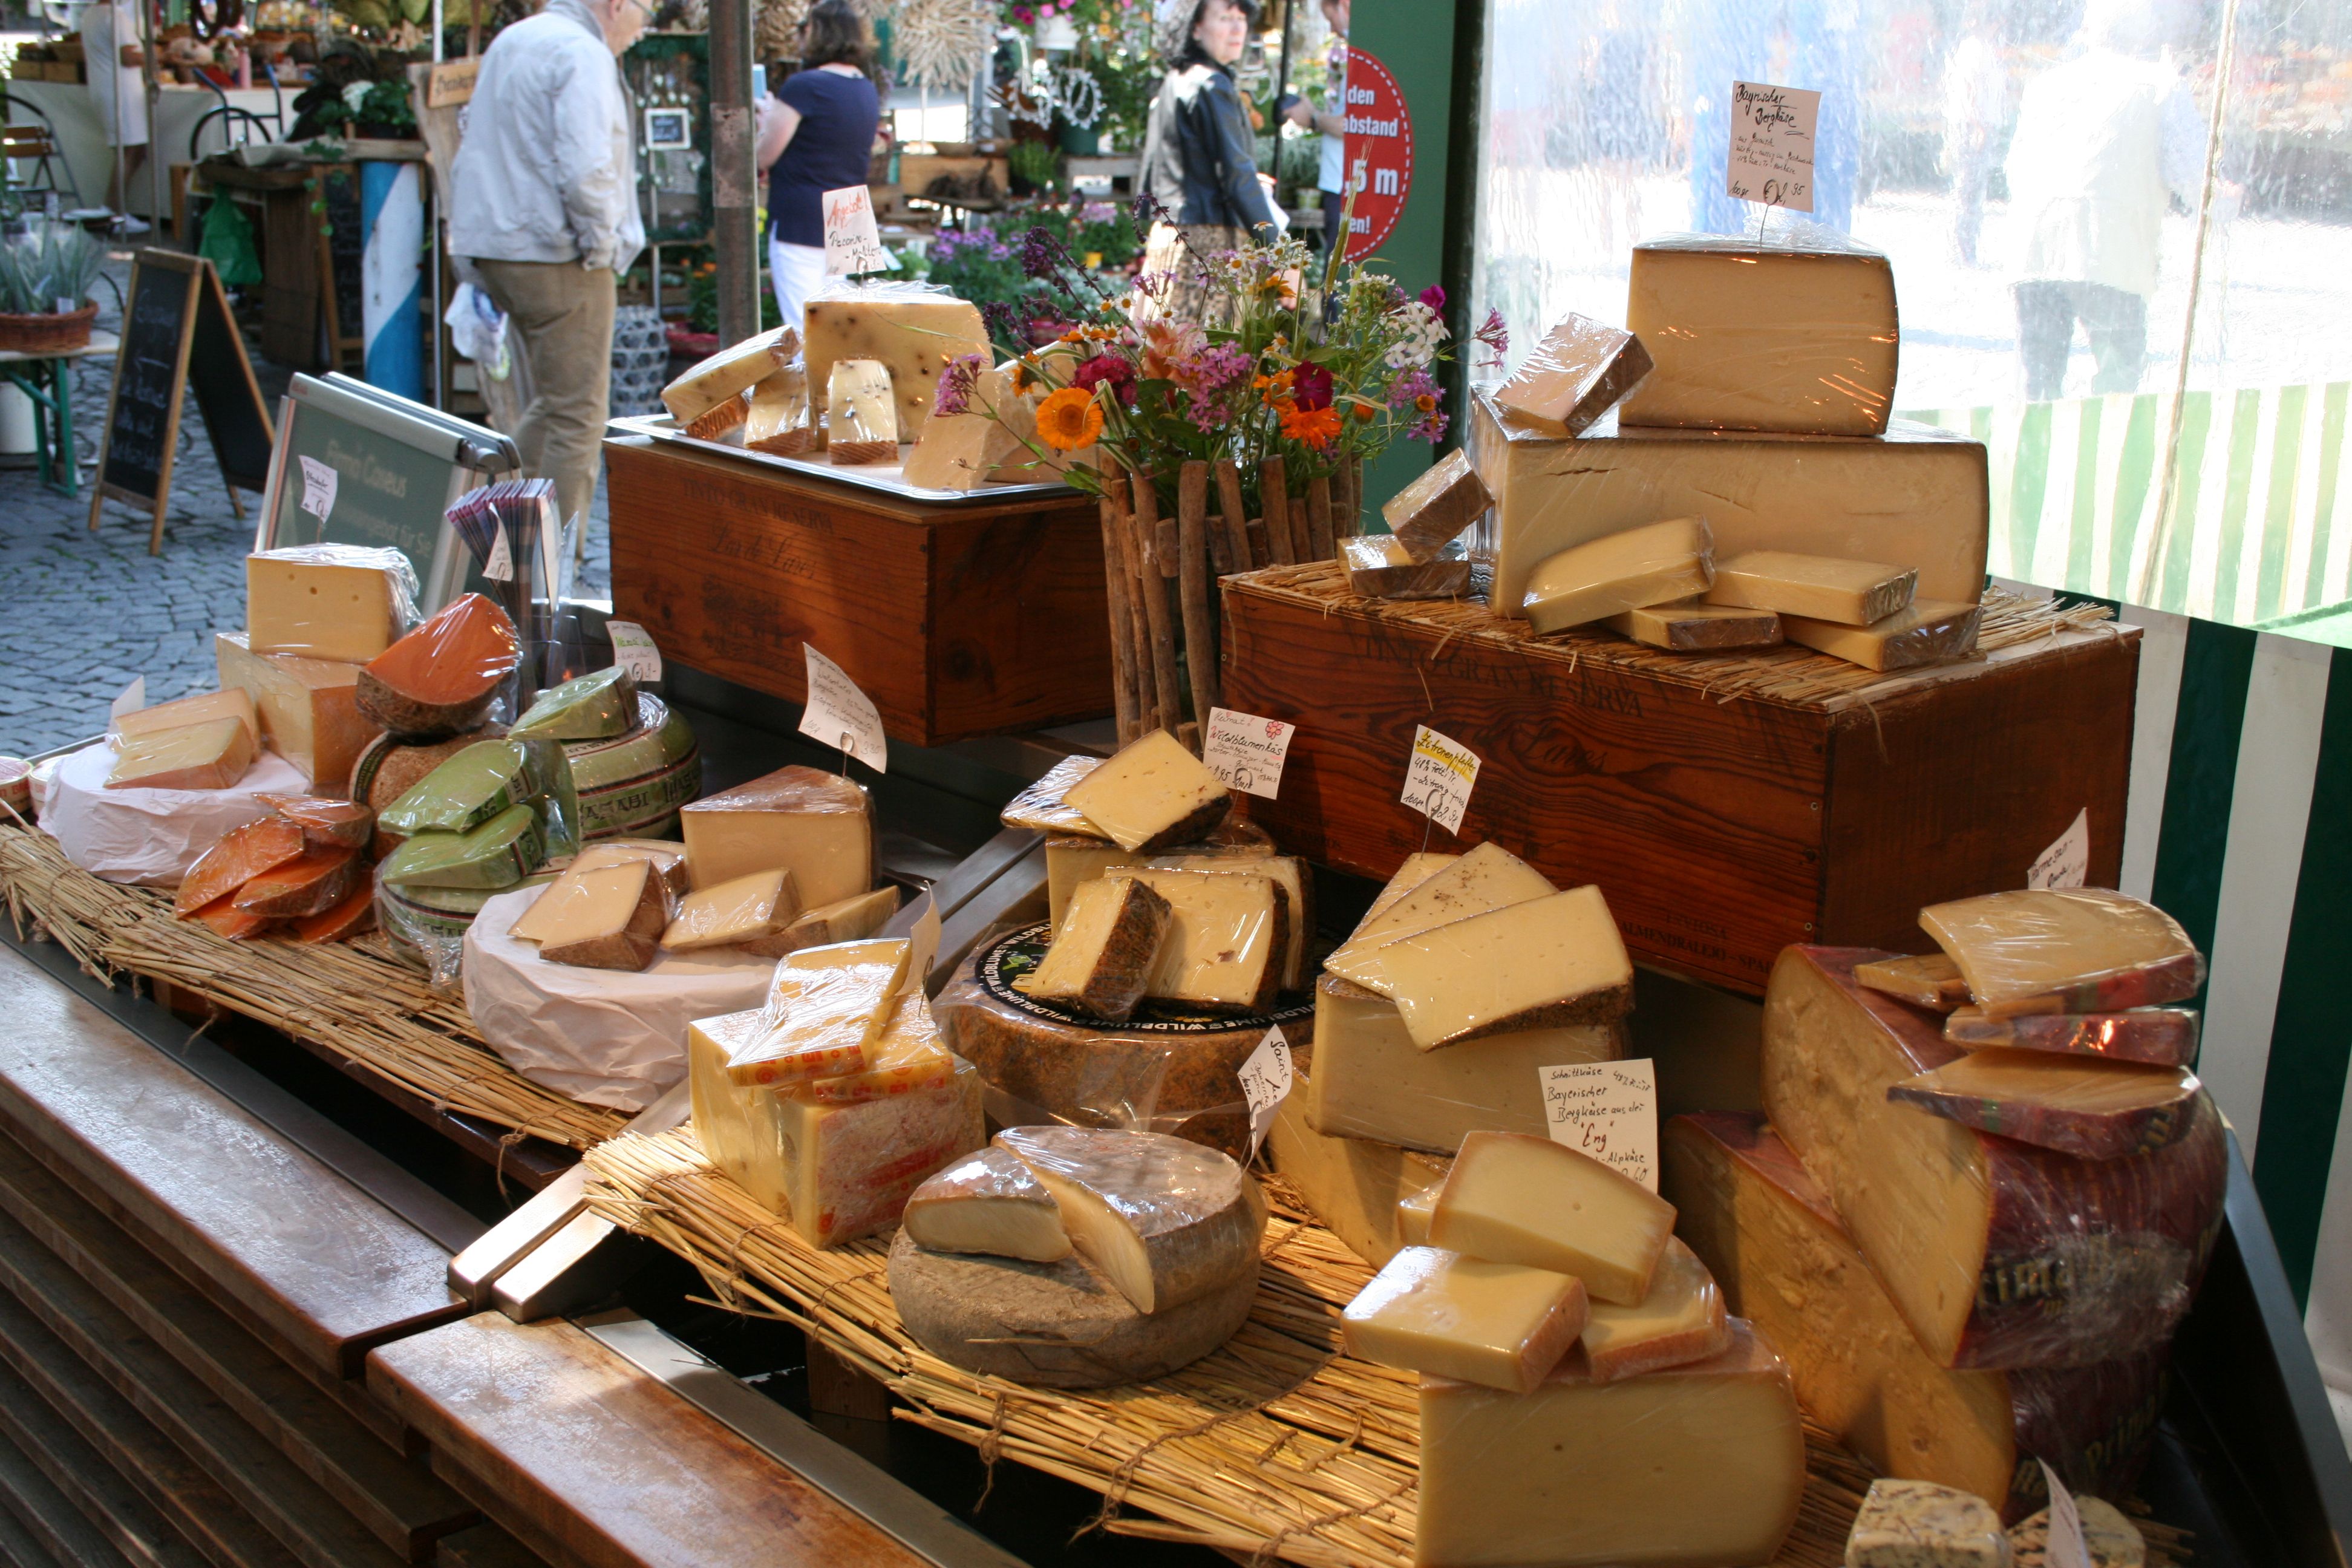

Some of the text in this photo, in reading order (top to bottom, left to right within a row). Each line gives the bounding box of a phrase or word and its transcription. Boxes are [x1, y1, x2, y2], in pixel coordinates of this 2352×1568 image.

[1348, 85, 1374, 105] den
[1374, 168, 1398, 196] m
[1451, 655, 1521, 693] GRAN
[1529, 671, 1644, 718] RESERVA
[1003, 924, 1051, 946] WILDBL
[984, 949, 1007, 987] WILDBLUME
[998, 990, 1071, 1022] WILDBLUME
[1089, 1018, 1206, 1030] WILDBLUME
[1270, 1040, 1289, 1082] Saint
[1547, 1085, 1608, 1106] Bayerischer
[1552, 1101, 1607, 1125] Bergkäse
